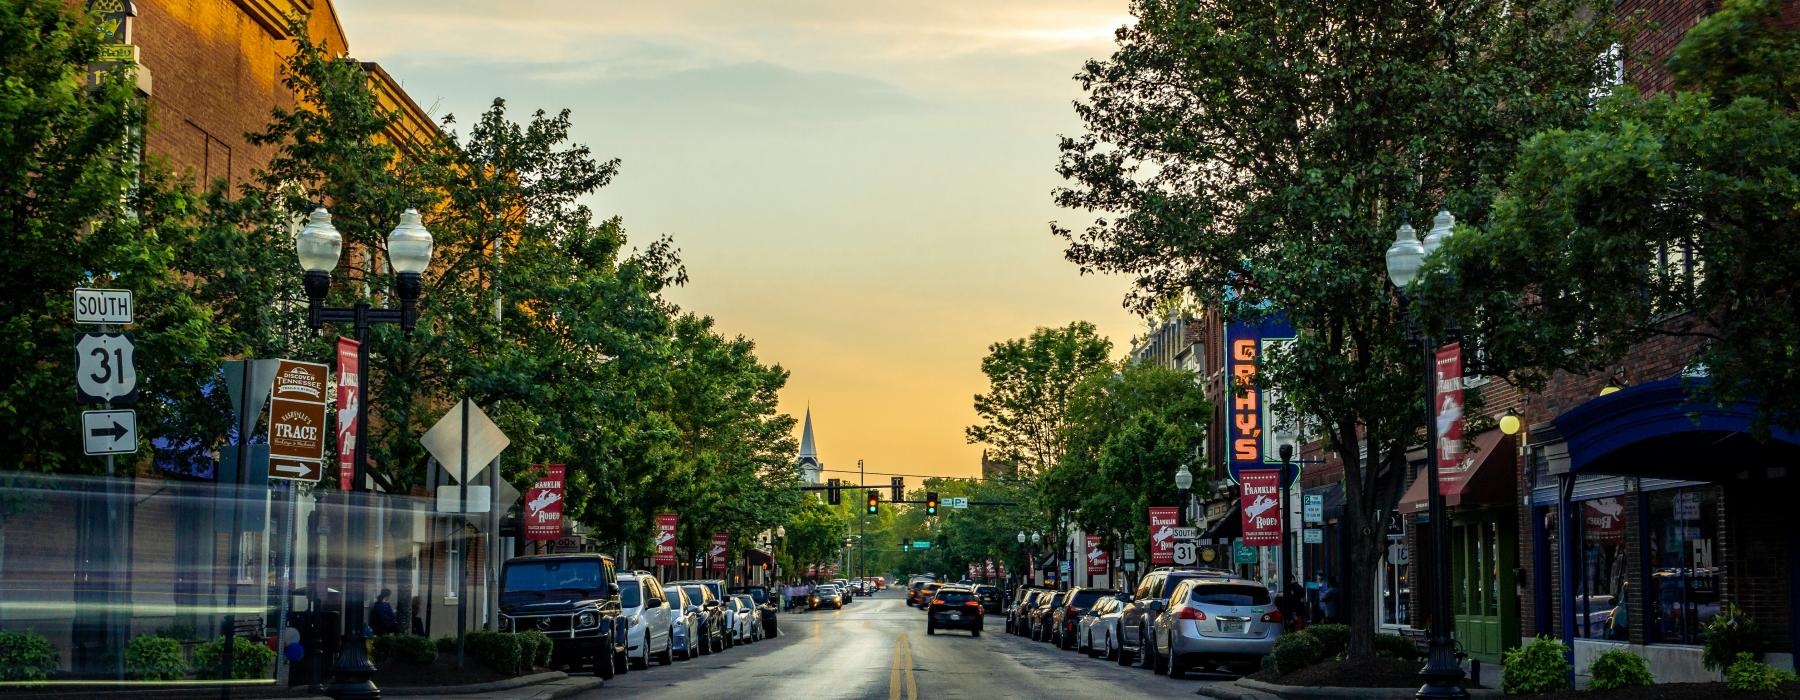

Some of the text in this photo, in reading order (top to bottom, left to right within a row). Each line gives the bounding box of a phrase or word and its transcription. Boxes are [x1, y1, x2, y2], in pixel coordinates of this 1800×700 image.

[79, 296, 128, 315] SOUTH
[90, 347, 124, 384] 31
[276, 376, 322, 390] TENNESSEE
[283, 373, 315, 381] DISCOVER
[281, 410, 312, 425] NASHVILLE'S
[275, 423, 318, 441] TRACE
[1244, 482, 1277, 496] FRANKLIN
[539, 510, 560, 523] RODEO
[1152, 516, 1177, 526] FRANKLIN
[1256, 516, 1278, 529] RODEO
[1178, 546, 1192, 560] 31
